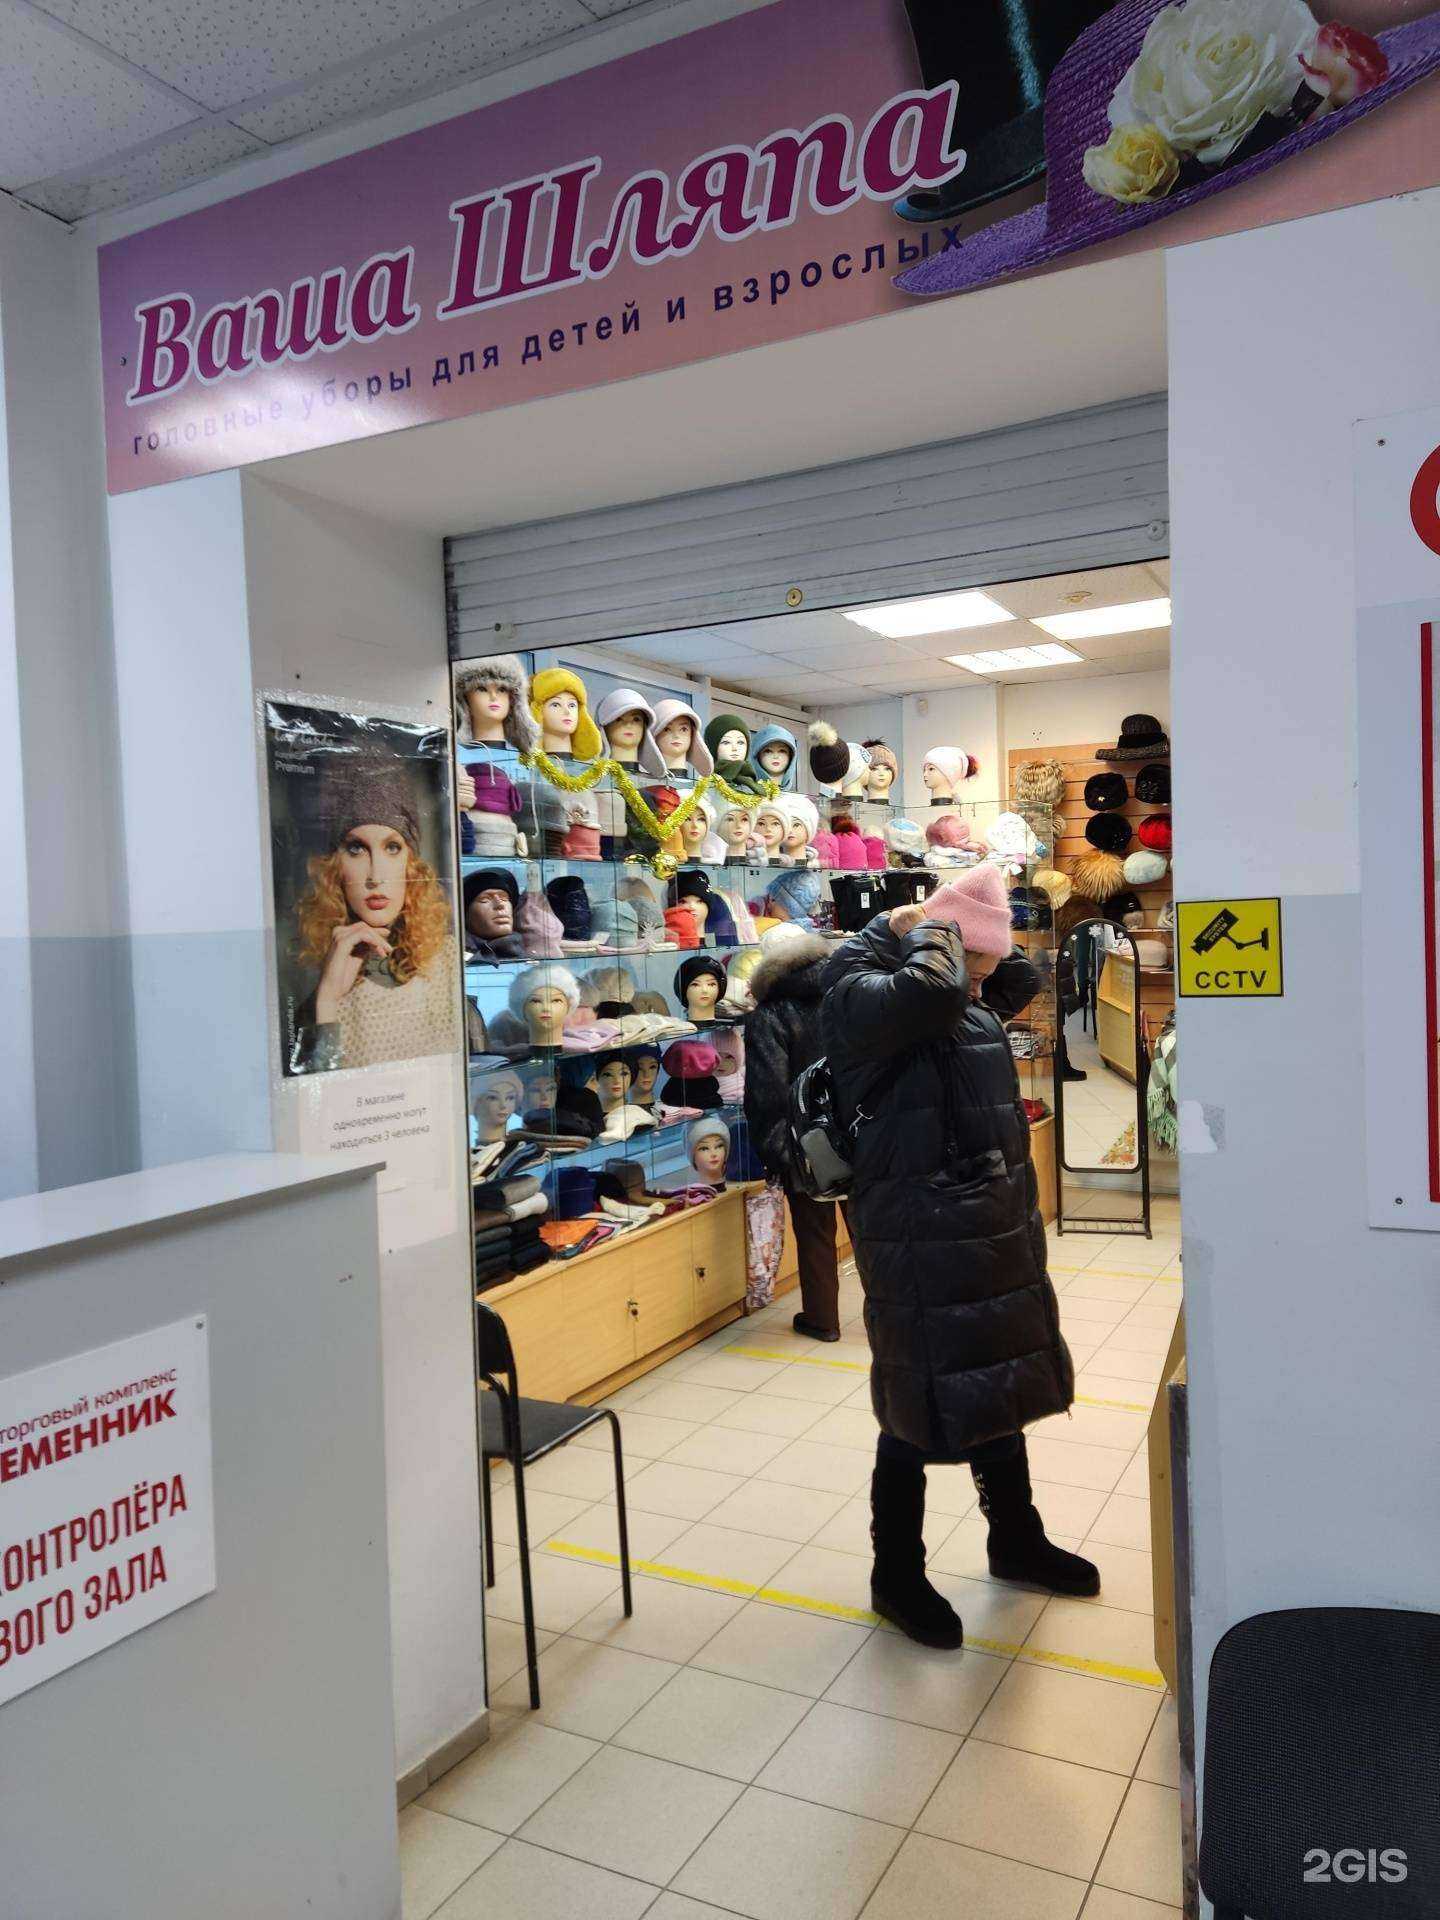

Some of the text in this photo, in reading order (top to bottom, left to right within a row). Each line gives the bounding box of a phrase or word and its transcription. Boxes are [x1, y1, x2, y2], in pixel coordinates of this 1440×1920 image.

[126, 80, 966, 405] Ваша Шляпа
[134, 223, 962, 454] головные уборы для детей и взрослых
[1195, 970, 1267, 989] CCTV
[0, 1369, 177, 1444] торговый комплекс
[0, 1388, 177, 1483] ЕМЕННИК
[0, 1474, 187, 1594] ОНТРОЛЁРА
[84, 1546, 167, 1620] ЗАЛА
